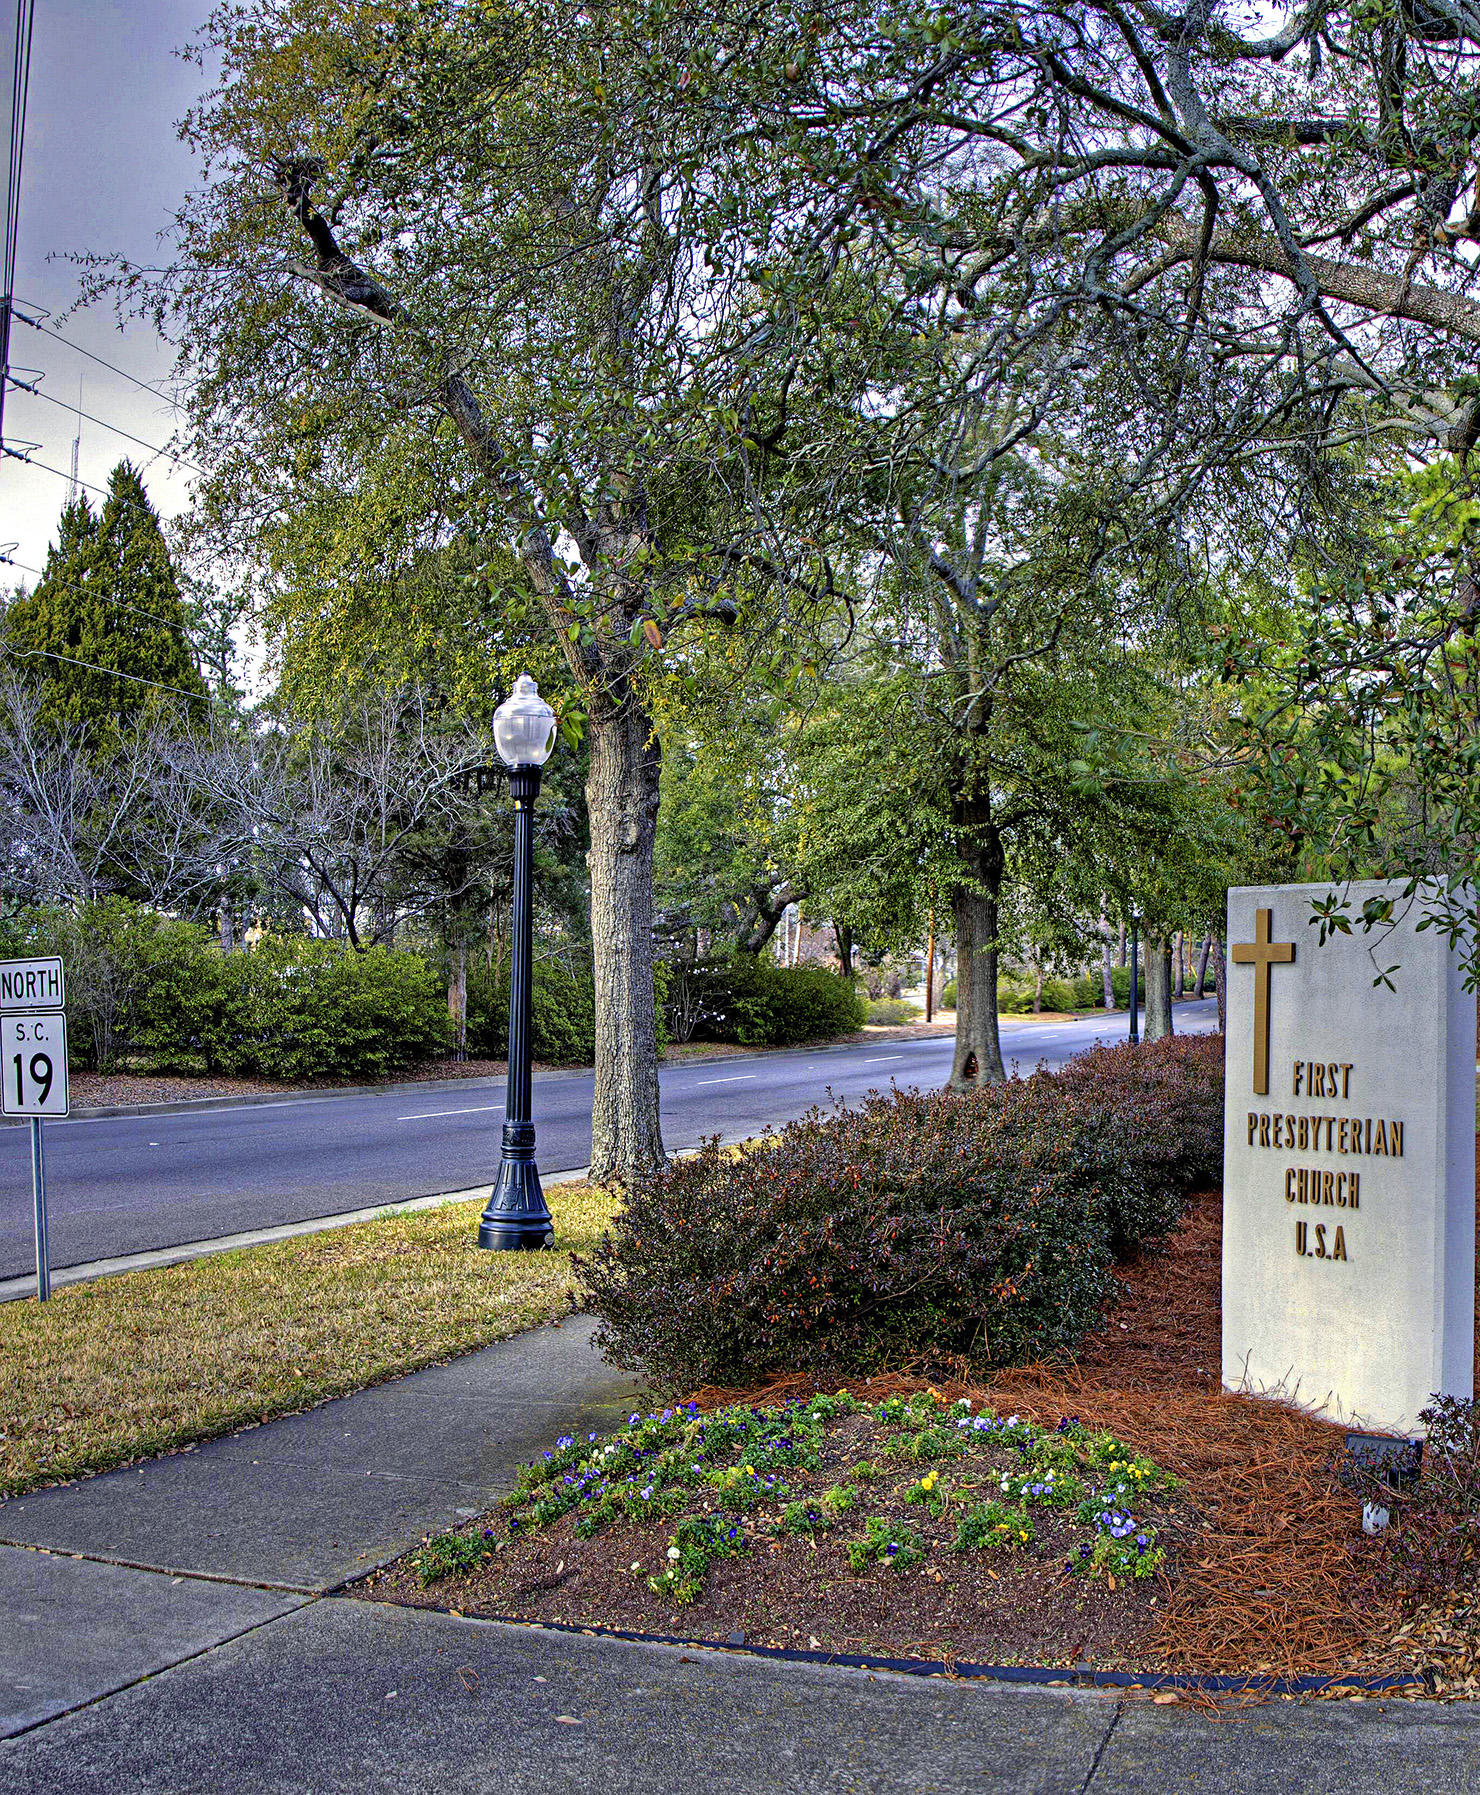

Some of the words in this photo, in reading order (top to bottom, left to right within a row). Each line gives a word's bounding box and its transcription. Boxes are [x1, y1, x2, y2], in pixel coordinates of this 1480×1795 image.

[2, 969, 59, 999] NORTH
[16, 1022, 49, 1041] S.C.
[13, 1053, 53, 1106] 19
[1293, 1061, 1354, 1099] FIRST
[1247, 1112, 1404, 1157] PRESBYTERIAN
[1284, 1168, 1360, 1209] CHURCH
